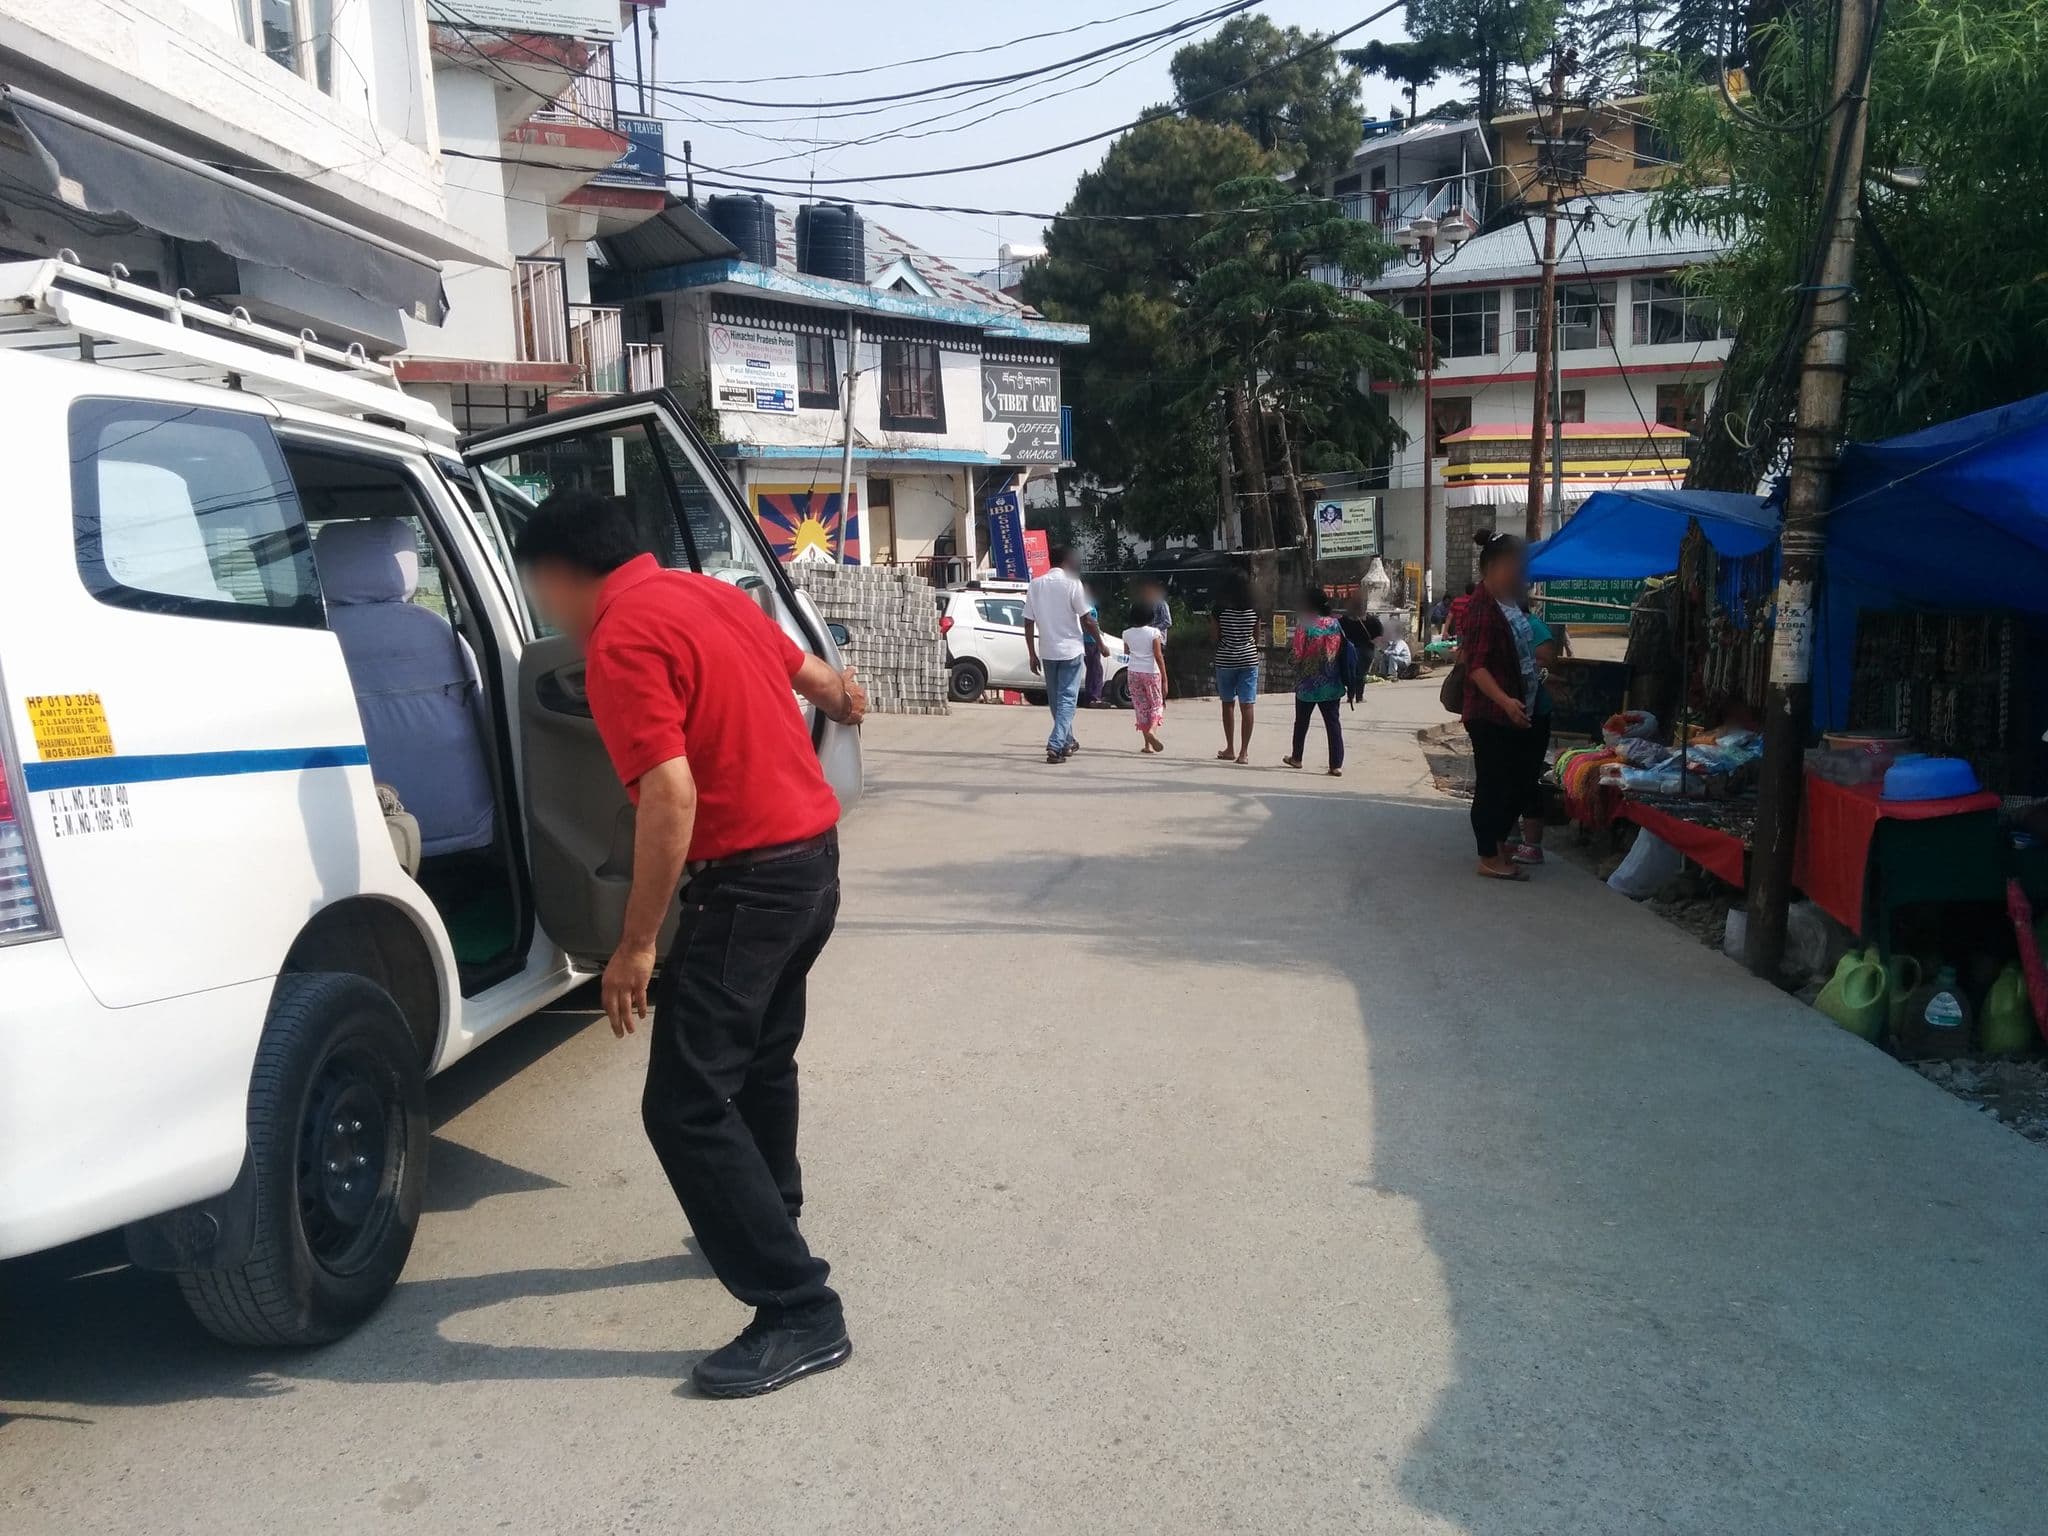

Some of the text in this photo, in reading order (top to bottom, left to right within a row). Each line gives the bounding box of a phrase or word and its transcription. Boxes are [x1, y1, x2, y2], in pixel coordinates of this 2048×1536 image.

[633, 122, 662, 135] TRAVELS
[730, 330, 794, 347] Himachal Pradesh Police
[747, 343, 782, 356] Smoking
[736, 350, 790, 362] Public Places
[720, 386, 748, 394] WESTERN
[997, 394, 1057, 412] TIBET CAFE
[1017, 423, 1055, 433] COFFEE
[1032, 437, 1041, 446] &
[1017, 450, 1058, 460] SNACKS
[990, 504, 1014, 515] IBD
[1571, 580, 1588, 590] TEMPLE
[1588, 580, 1608, 590] COMPLEX
[1610, 580, 1621, 590] 150
[1622, 580, 1633, 590] MTR
[1550, 612, 1570, 620] TOURIST
[1572, 612, 1586, 620] HELP
[26, 694, 101, 709] HP 01 D 3264
[40, 708, 94, 717] AMIT GUPTA
[86, 716, 106, 724] GUPTA
